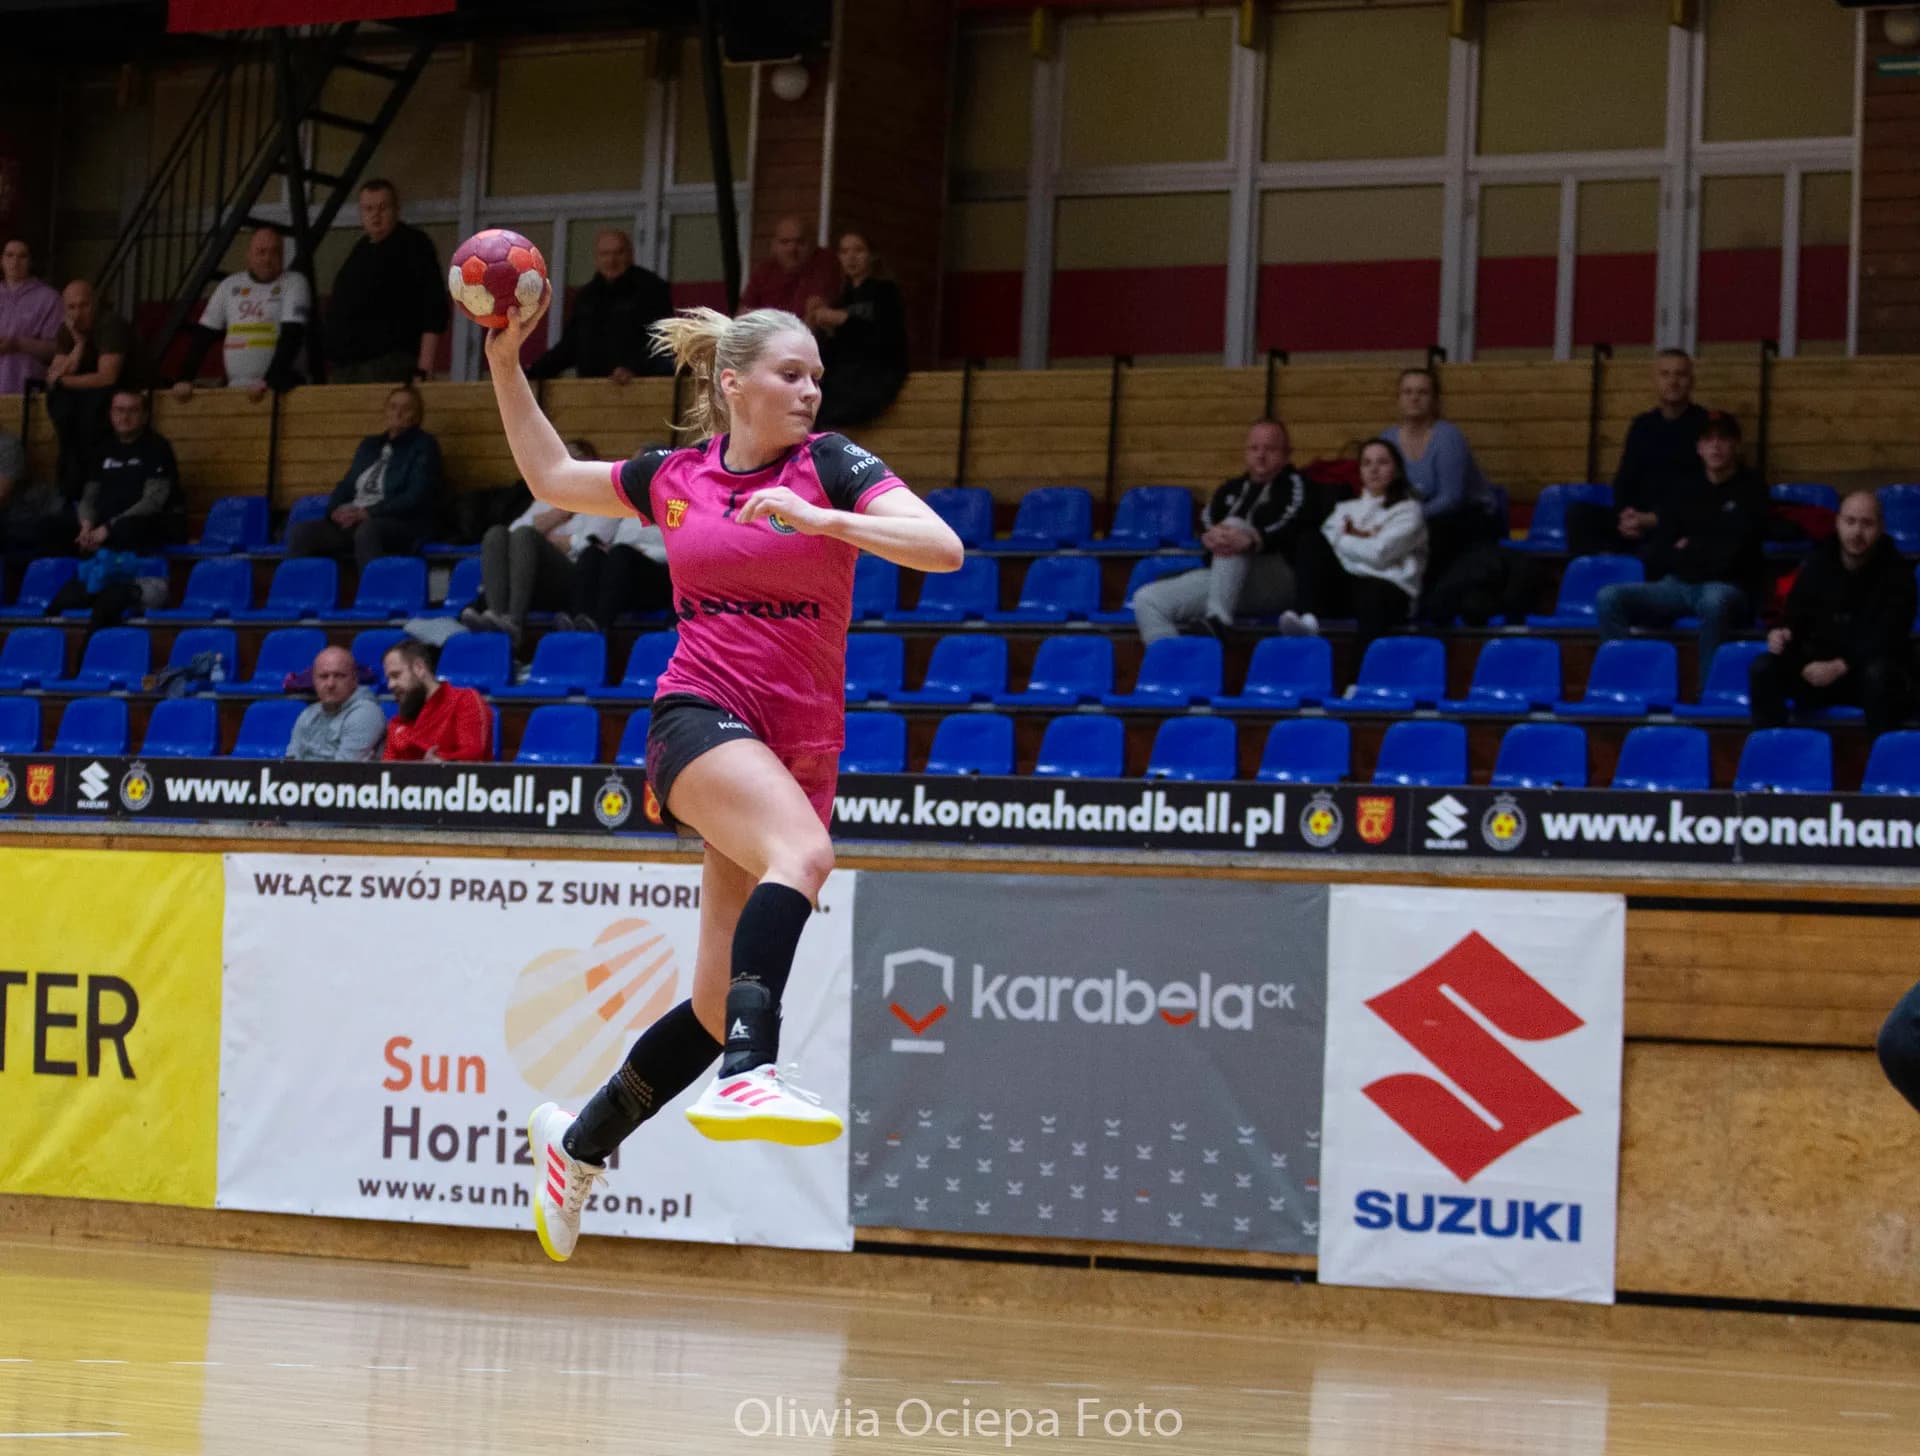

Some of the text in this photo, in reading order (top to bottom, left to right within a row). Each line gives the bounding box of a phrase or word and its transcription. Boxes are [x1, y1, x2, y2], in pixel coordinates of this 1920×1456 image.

[701, 599, 820, 620] SUZUKI
[165, 767, 581, 827] www.koronahandball.pl
[831, 785, 1284, 848] ww.koronahandball.pl
[254, 870, 701, 910] WŁĄCZ SWÓJ PRĄD Z SUN HORI
[971, 964, 1296, 1031] karabela CK
[382, 1036, 486, 1094] Sun
[382, 1105, 619, 1170] Horiz
[358, 1177, 693, 1221] www.sunhzon.pl
[1353, 1189, 1582, 1243] SUZUKI
